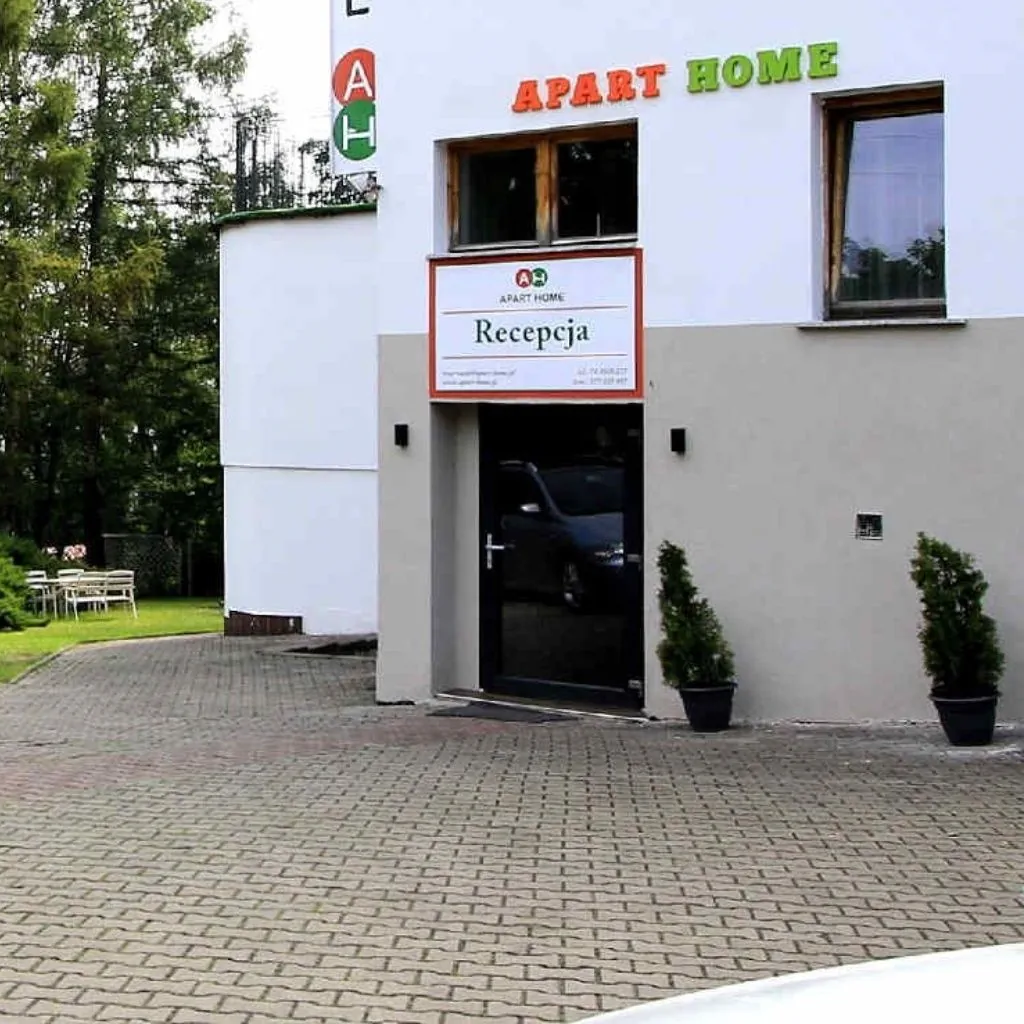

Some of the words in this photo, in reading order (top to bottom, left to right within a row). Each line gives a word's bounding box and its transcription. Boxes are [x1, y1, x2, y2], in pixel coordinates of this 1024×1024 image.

[512, 64, 666, 112] APART
[686, 42, 838, 93] HOME
[499, 293, 532, 304] APART
[534, 292, 565, 303] HOME
[475, 317, 590, 351] Recepcja
